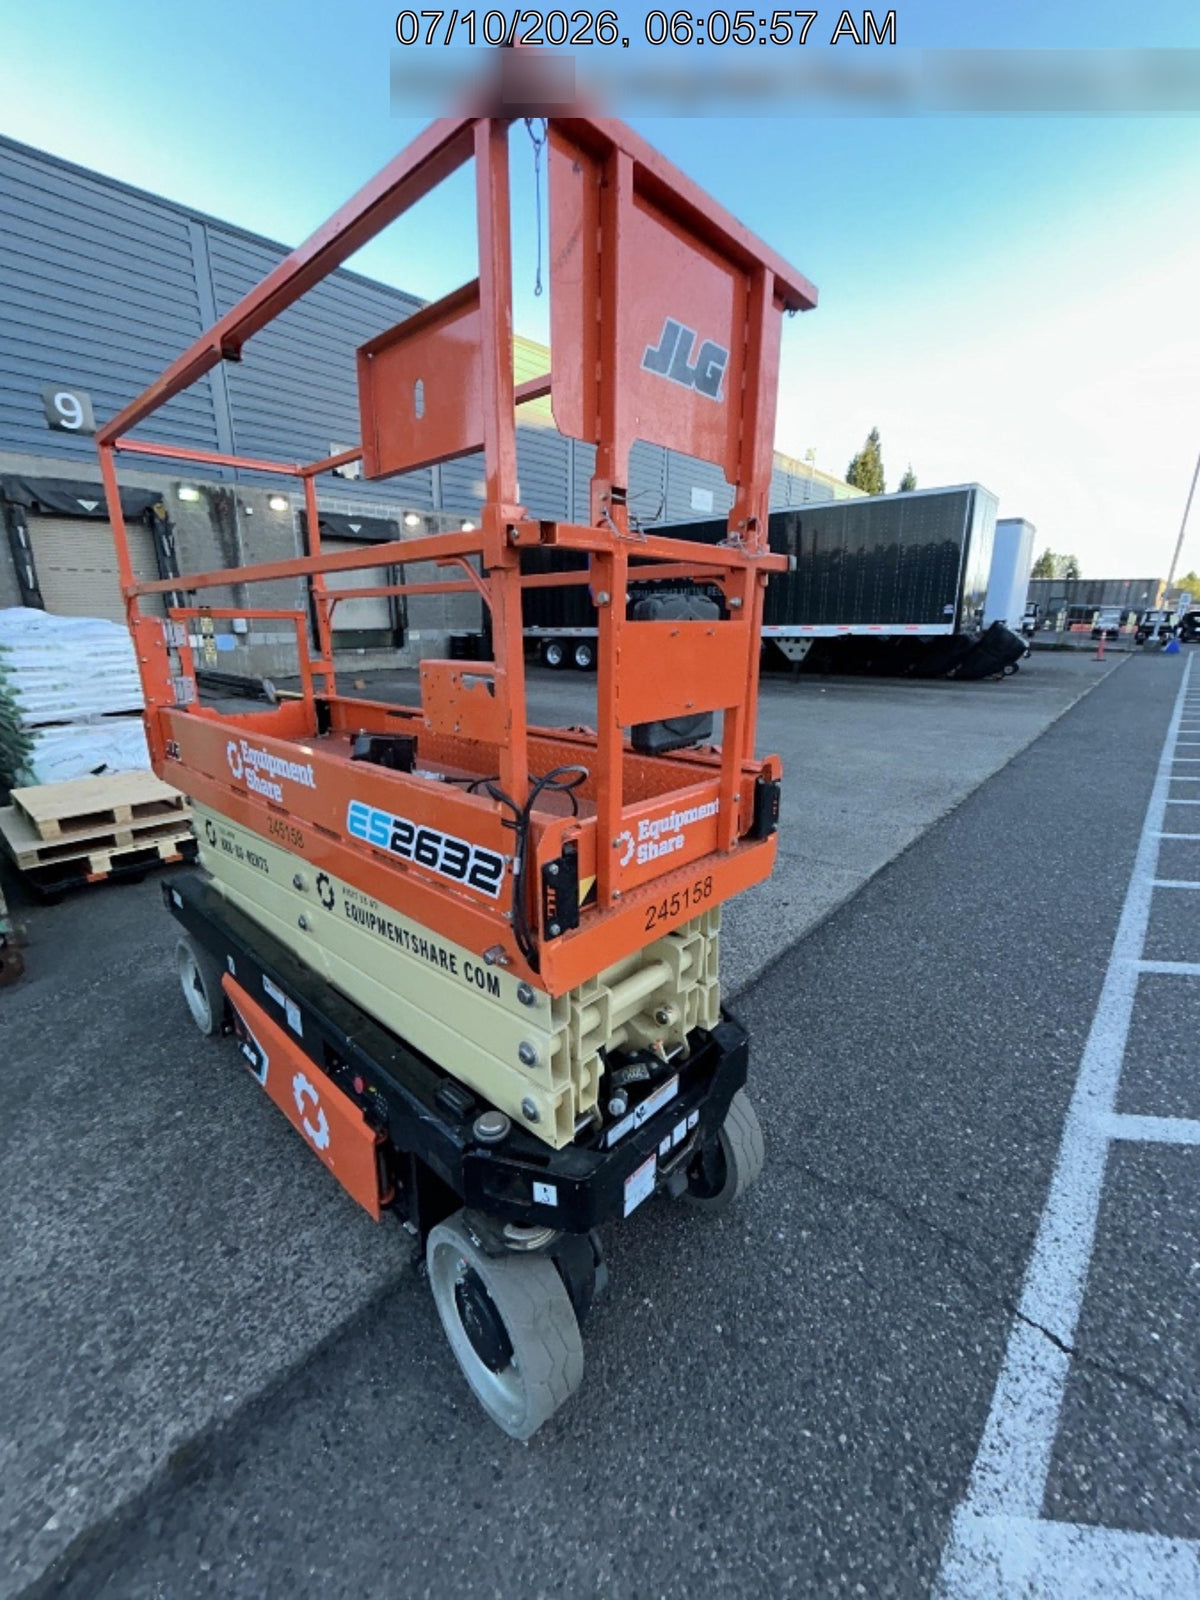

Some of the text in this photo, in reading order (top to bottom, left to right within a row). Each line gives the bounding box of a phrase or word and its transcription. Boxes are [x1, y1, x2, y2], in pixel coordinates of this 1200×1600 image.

[640, 316, 730, 403] JLG
[54, 391, 84, 429] 9
[240, 739, 317, 789] Equipment
[244, 767, 284, 803] Share
[347, 799, 505, 899] ES2632
[636, 834, 684, 865] Share
[645, 875, 713, 932] 245158
